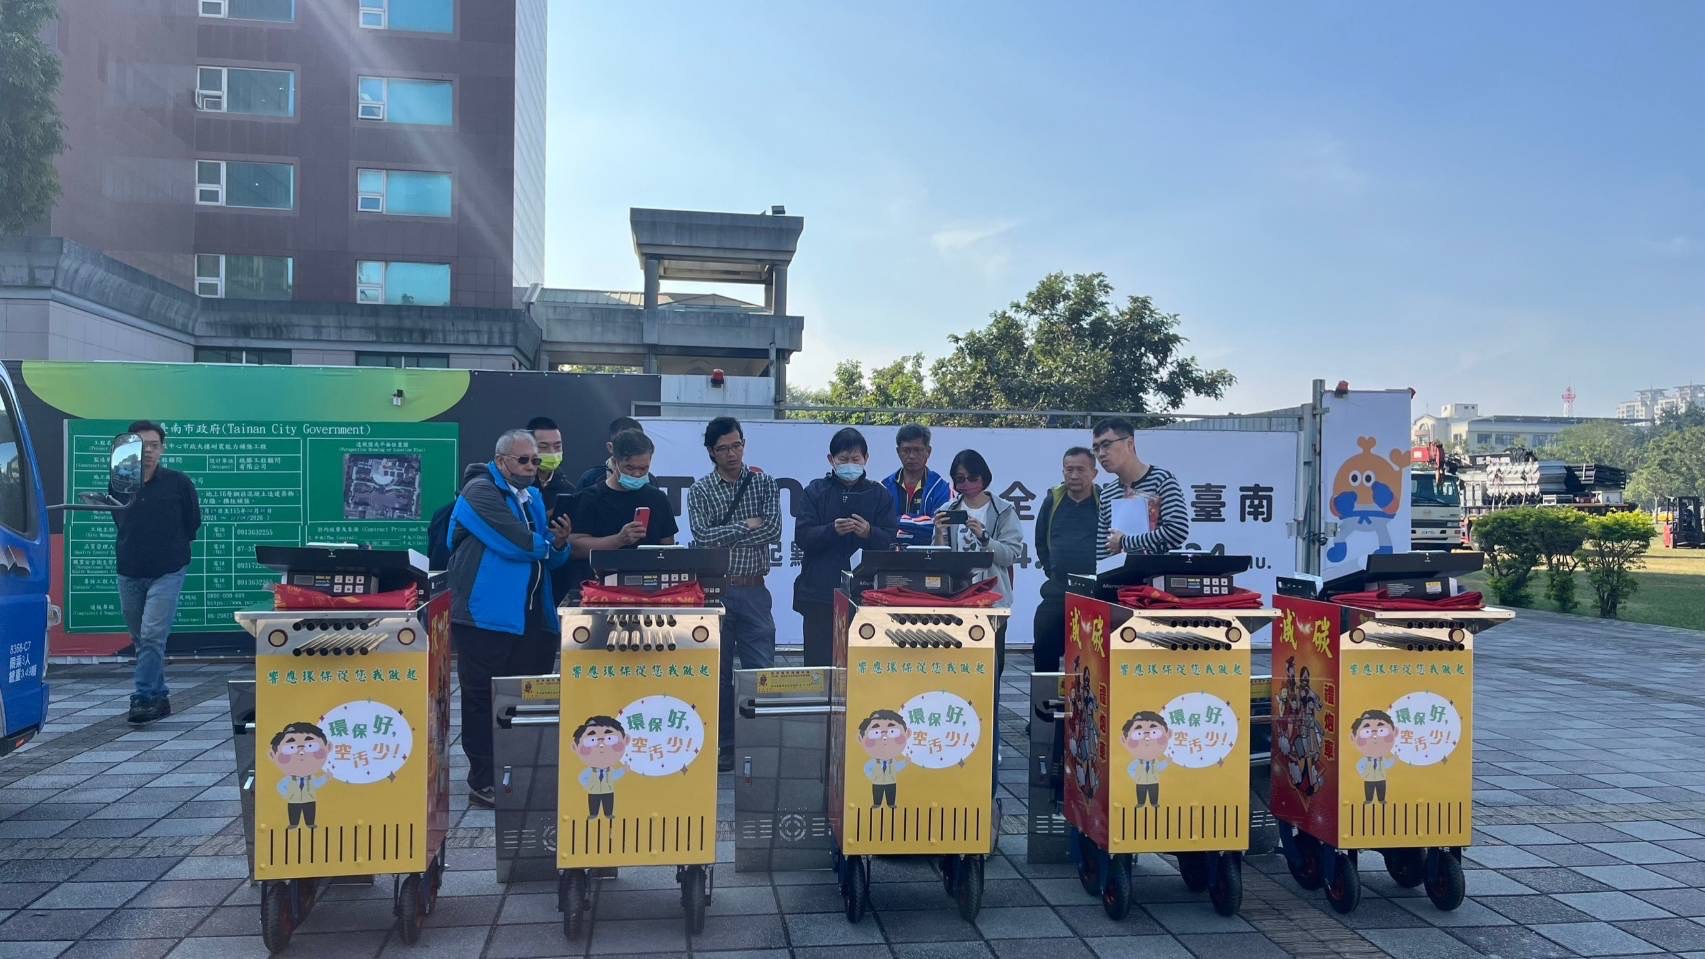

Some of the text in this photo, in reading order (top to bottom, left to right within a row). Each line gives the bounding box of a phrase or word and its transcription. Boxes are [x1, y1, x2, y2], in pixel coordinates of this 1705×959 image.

[271, 423, 297, 436] City
[303, 424, 370, 436] Government)
[1190, 483, 1274, 523] 臺南
